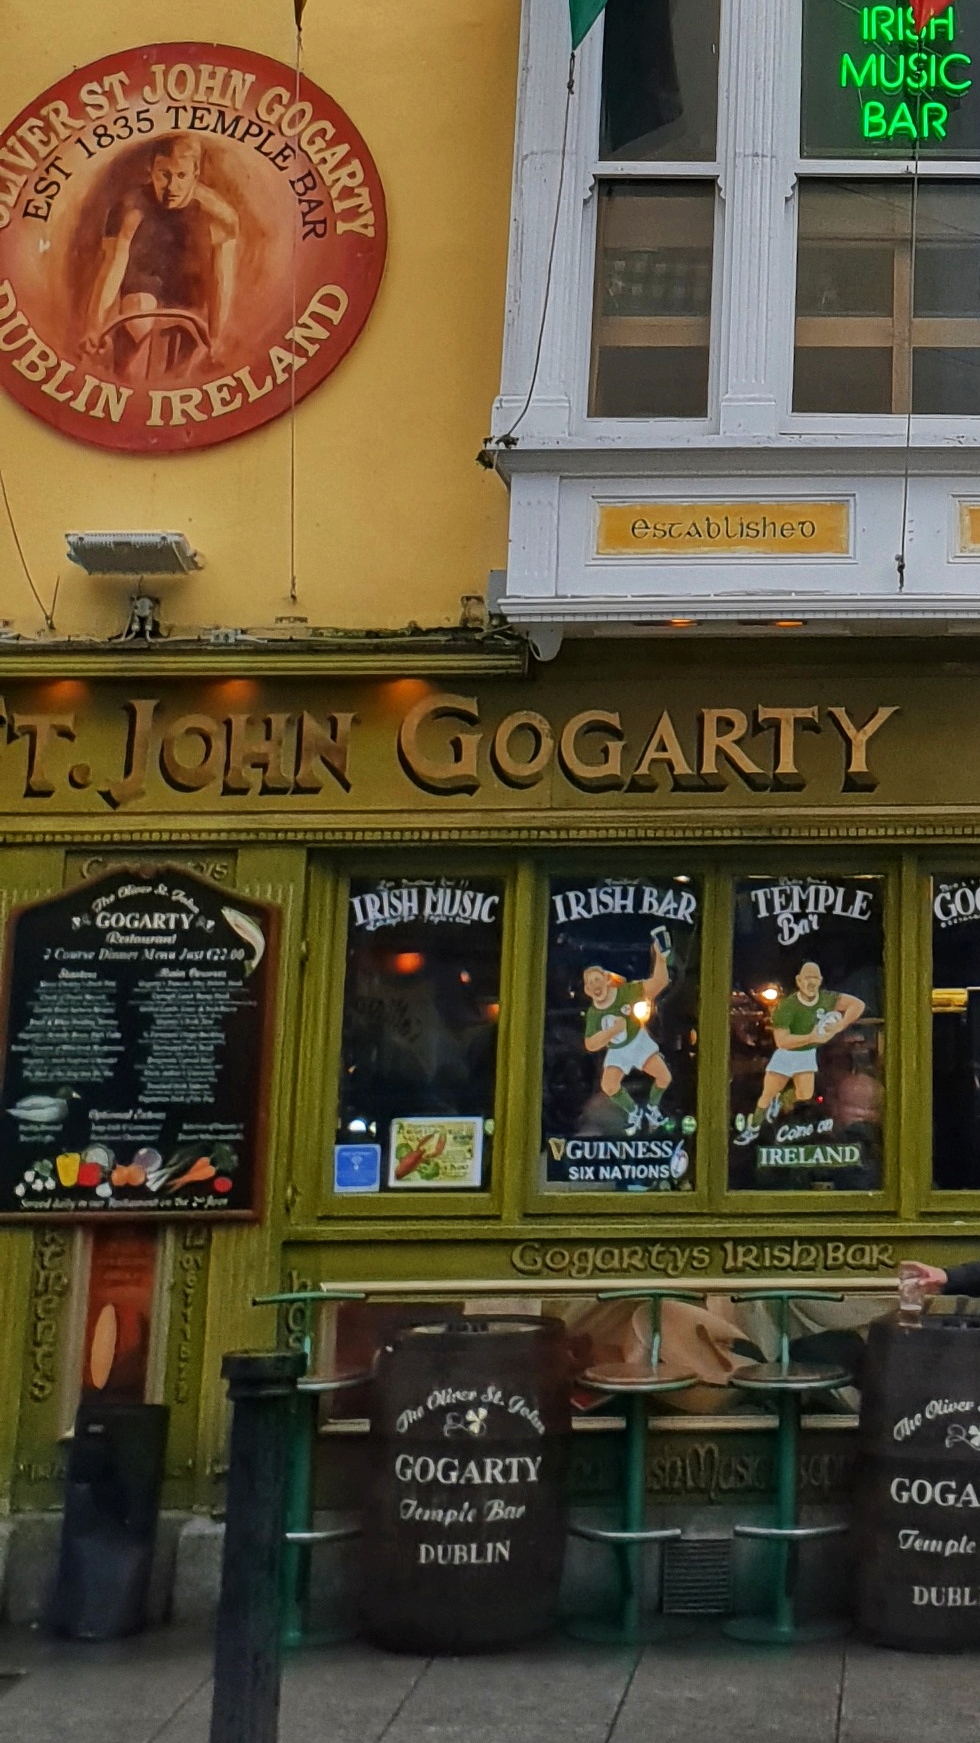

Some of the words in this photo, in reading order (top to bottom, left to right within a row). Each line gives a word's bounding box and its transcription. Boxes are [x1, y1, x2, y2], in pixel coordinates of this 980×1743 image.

[862, 5, 955, 42] IRISH
[841, 52, 973, 90] MUSIC
[863, 101, 949, 140] BAR
[79, 70, 131, 122] ST
[142, 63, 256, 110] JOHN
[257, 85, 377, 239] GOGARTY
[22, 156, 74, 224] EST
[75, 108, 156, 160] 1835
[165, 105, 302, 173] TEMPLE
[288, 169, 328, 242] BAR
[146, 283, 350, 428] IRELAND
[98, 697, 359, 811] JOHN
[397, 693, 901, 800] GOGARTY
[95, 911, 195, 930] GOGARTY
[350, 887, 419, 927] IRISH
[423, 887, 500, 924] MUSIC
[552, 886, 635, 925] IRISH
[638, 886, 698, 925] BAR
[750, 884, 874, 921] TEMPLE
[776, 912, 820, 946] Bar
[566, 1140, 673, 1160] GUINNESS
[760, 1145, 860, 1165] IRELAND
[568, 1165, 595, 1180] SIX
[600, 1164, 670, 1180] NATIONS
[396, 1405, 425, 1433] The
[426, 1387, 477, 1411] Oliver
[893, 1412, 922, 1442] The
[925, 1398, 975, 1420] Oliver
[395, 1454, 542, 1485] GOGARTY
[400, 1499, 477, 1528] Temple
[486, 1499, 527, 1522] Bar
[418, 1540, 511, 1565] DUBLIN
[898, 1529, 977, 1557] Temple
